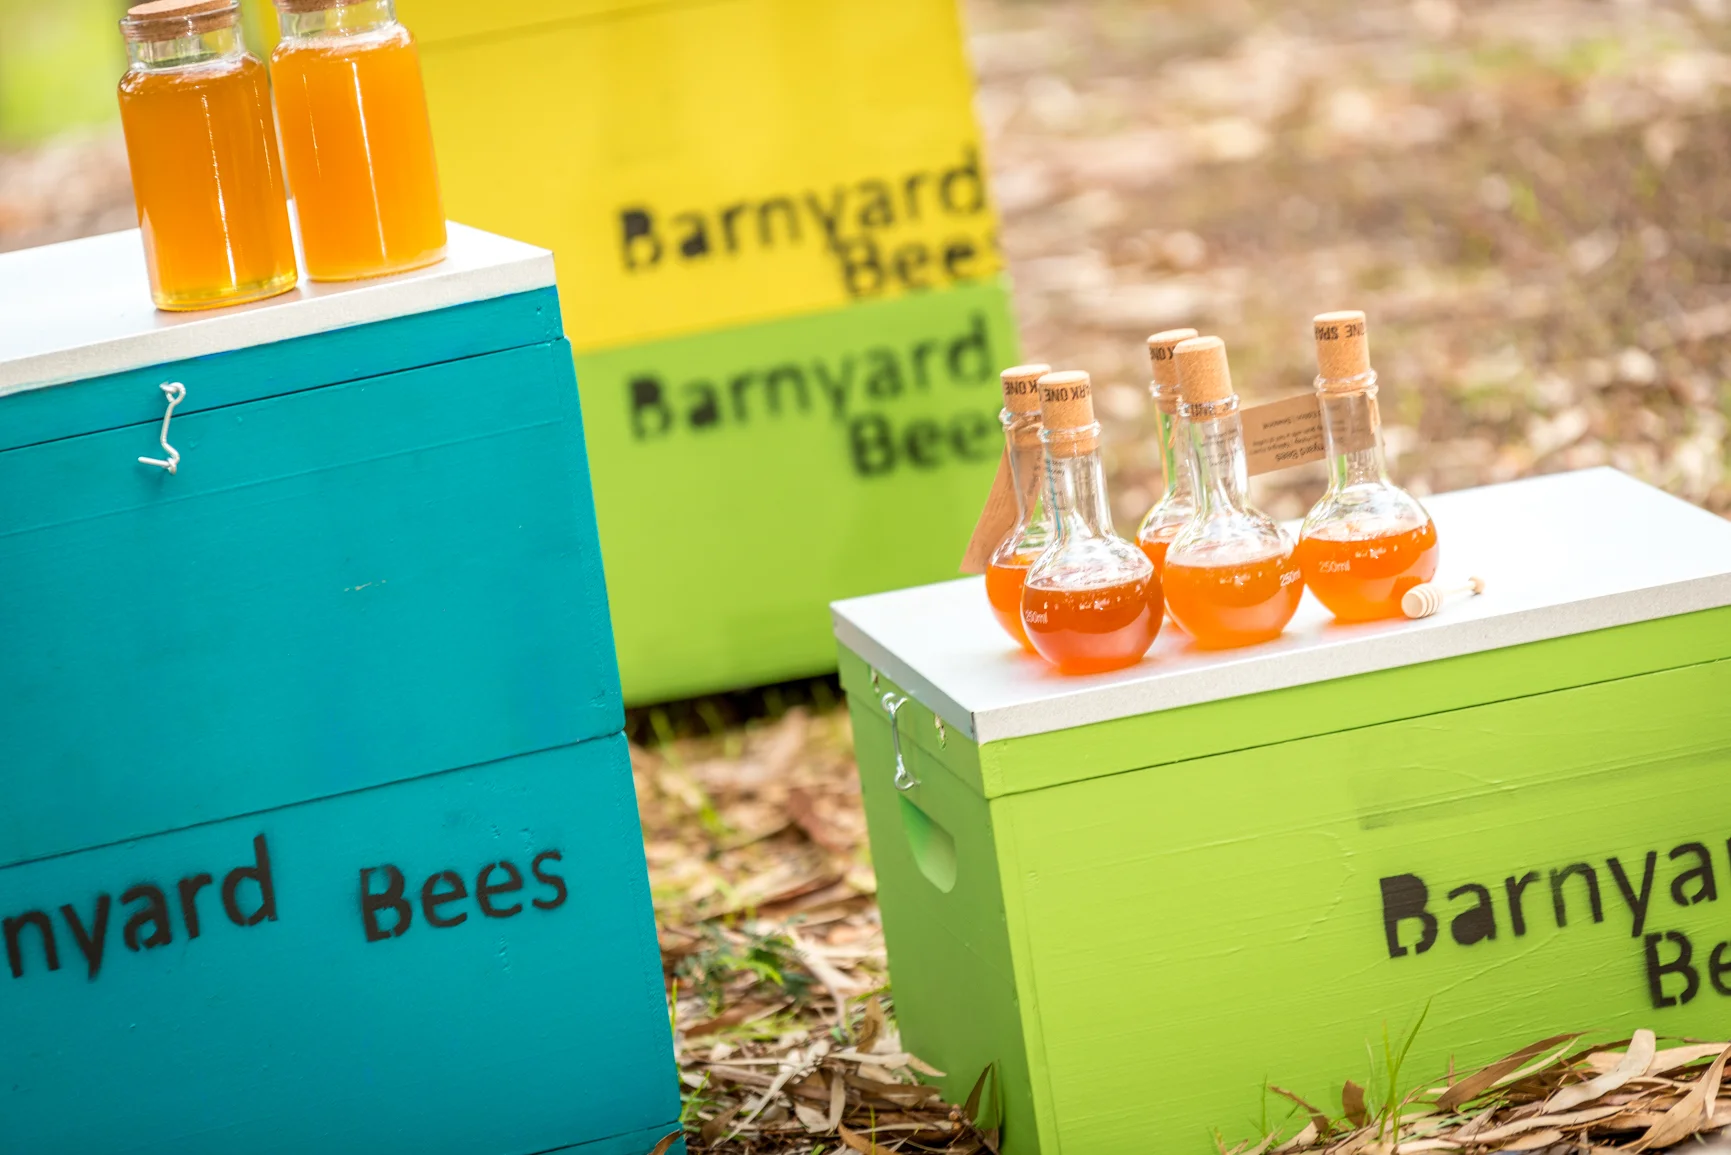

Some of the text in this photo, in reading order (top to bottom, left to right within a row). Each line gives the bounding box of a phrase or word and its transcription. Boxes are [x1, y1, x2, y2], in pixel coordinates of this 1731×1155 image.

[619, 145, 985, 271] Barnyard
[627, 313, 993, 441] Barnyard
[1043, 388, 1069, 402] ONE
[849, 406, 1000, 478] Bee
[1319, 560, 1351, 574] 250ml
[1, 833, 569, 982] nyard Bees
[1380, 838, 1731, 958] Barnya
